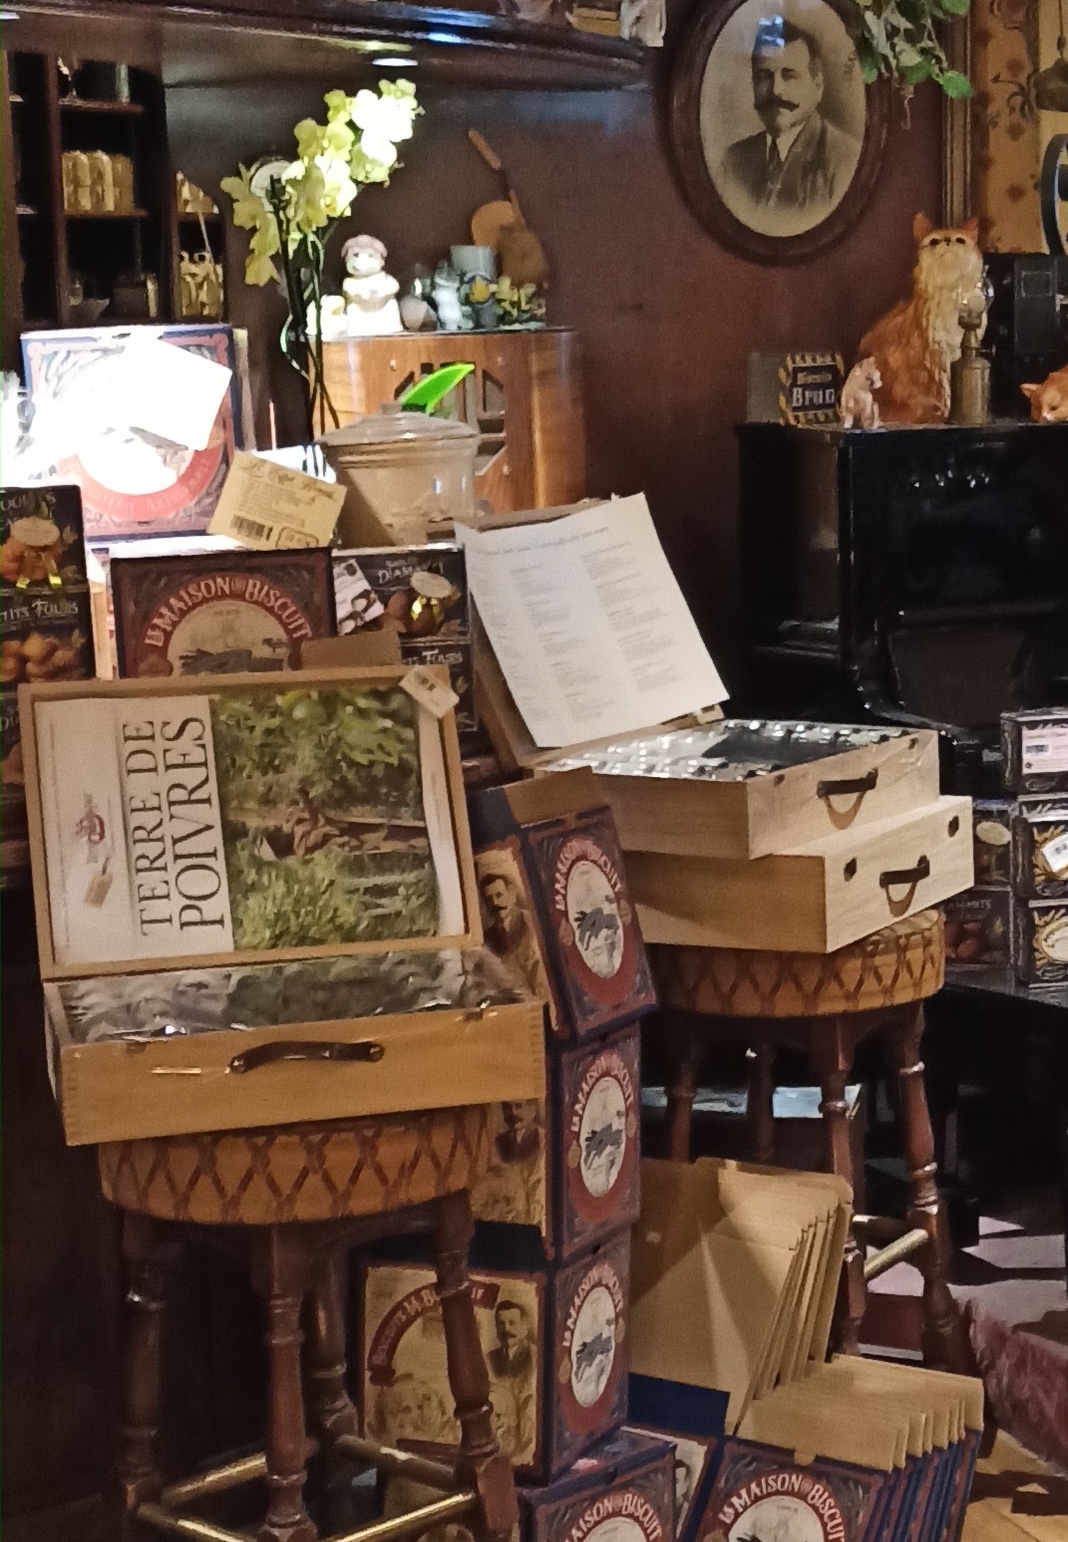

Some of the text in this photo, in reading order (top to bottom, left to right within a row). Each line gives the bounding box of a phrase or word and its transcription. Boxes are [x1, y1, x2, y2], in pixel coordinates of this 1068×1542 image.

[152, 575, 230, 632] MAISON
[245, 578, 313, 639] BISCUIT
[122, 720, 174, 936] TERRE DE
[161, 717, 225, 931] POIVRES
[730, 1472, 803, 1514] MAISON
